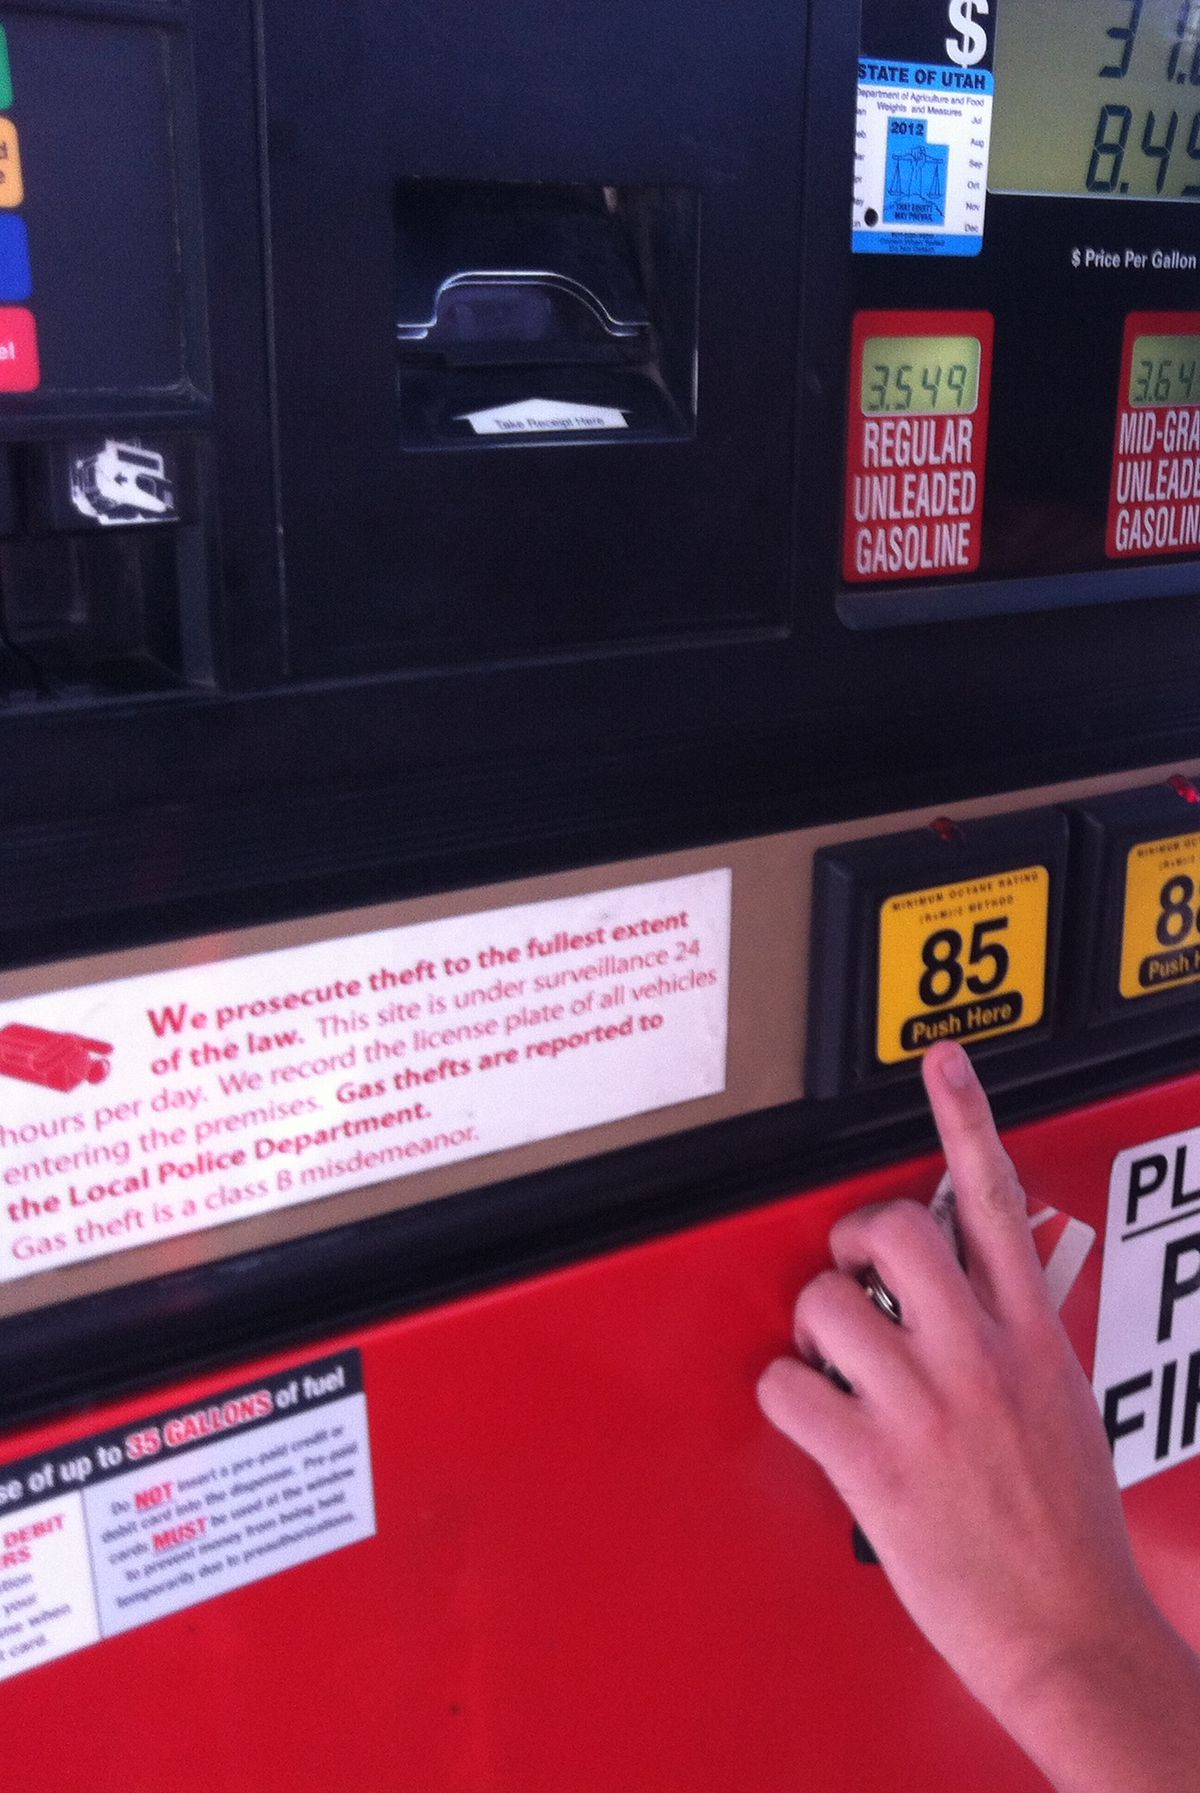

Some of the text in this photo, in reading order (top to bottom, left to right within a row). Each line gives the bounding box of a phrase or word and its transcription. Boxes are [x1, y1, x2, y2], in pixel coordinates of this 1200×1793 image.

[858, 63, 985, 90] STATE OF UTAH
[901, 92, 909, 100] of
[910, 93, 949, 105] Agriculture
[951, 97, 964, 106] and
[966, 98, 984, 107] Food
[877, 101, 962, 117] Weights and Measures
[891, 121, 924, 136] 2012
[1071, 248, 1081, 269] $
[1085, 248, 1121, 269] Price
[1124, 248, 1148, 269] Per
[1151, 248, 1197, 270] Gallon
[867, 364, 968, 411] 3.549
[863, 420, 972, 468] REGULAR
[853, 470, 976, 521] UNLEADED
[856, 522, 969, 575] GASOLINE
[892, 872, 1039, 911] MINIMUM OCTANE RATING
[968, 894, 1014, 912] METHOD
[147, 911, 688, 1038] We prosecute theft to the fullest extent
[918, 915, 1009, 1008] 85
[1149, 954, 1189, 980] Push
[151, 939, 701, 1076] of the law. This site is under surveillance 24
[912, 1003, 1012, 1043] Push Here
[0, 967, 718, 1147] hours per day. We record the license plate of all vehicles
[3, 1012, 664, 1186] entering the premises. Gas thefts are reported to
[7, 1101, 432, 1224] the Local Police Department.
[11, 1124, 479, 1262] Gas theft is a class B misdemeanor.
[28, 1463, 55, 1493] of
[59, 1456, 93, 1482] up
[98, 1445, 122, 1469] to
[126, 1428, 162, 1461] 35
[163, 1389, 273, 1448] GALLONS
[275, 1379, 299, 1408] of
[302, 1365, 346, 1399] fuel
[134, 1481, 173, 1511] NOT
[152, 1516, 208, 1552] MUST
